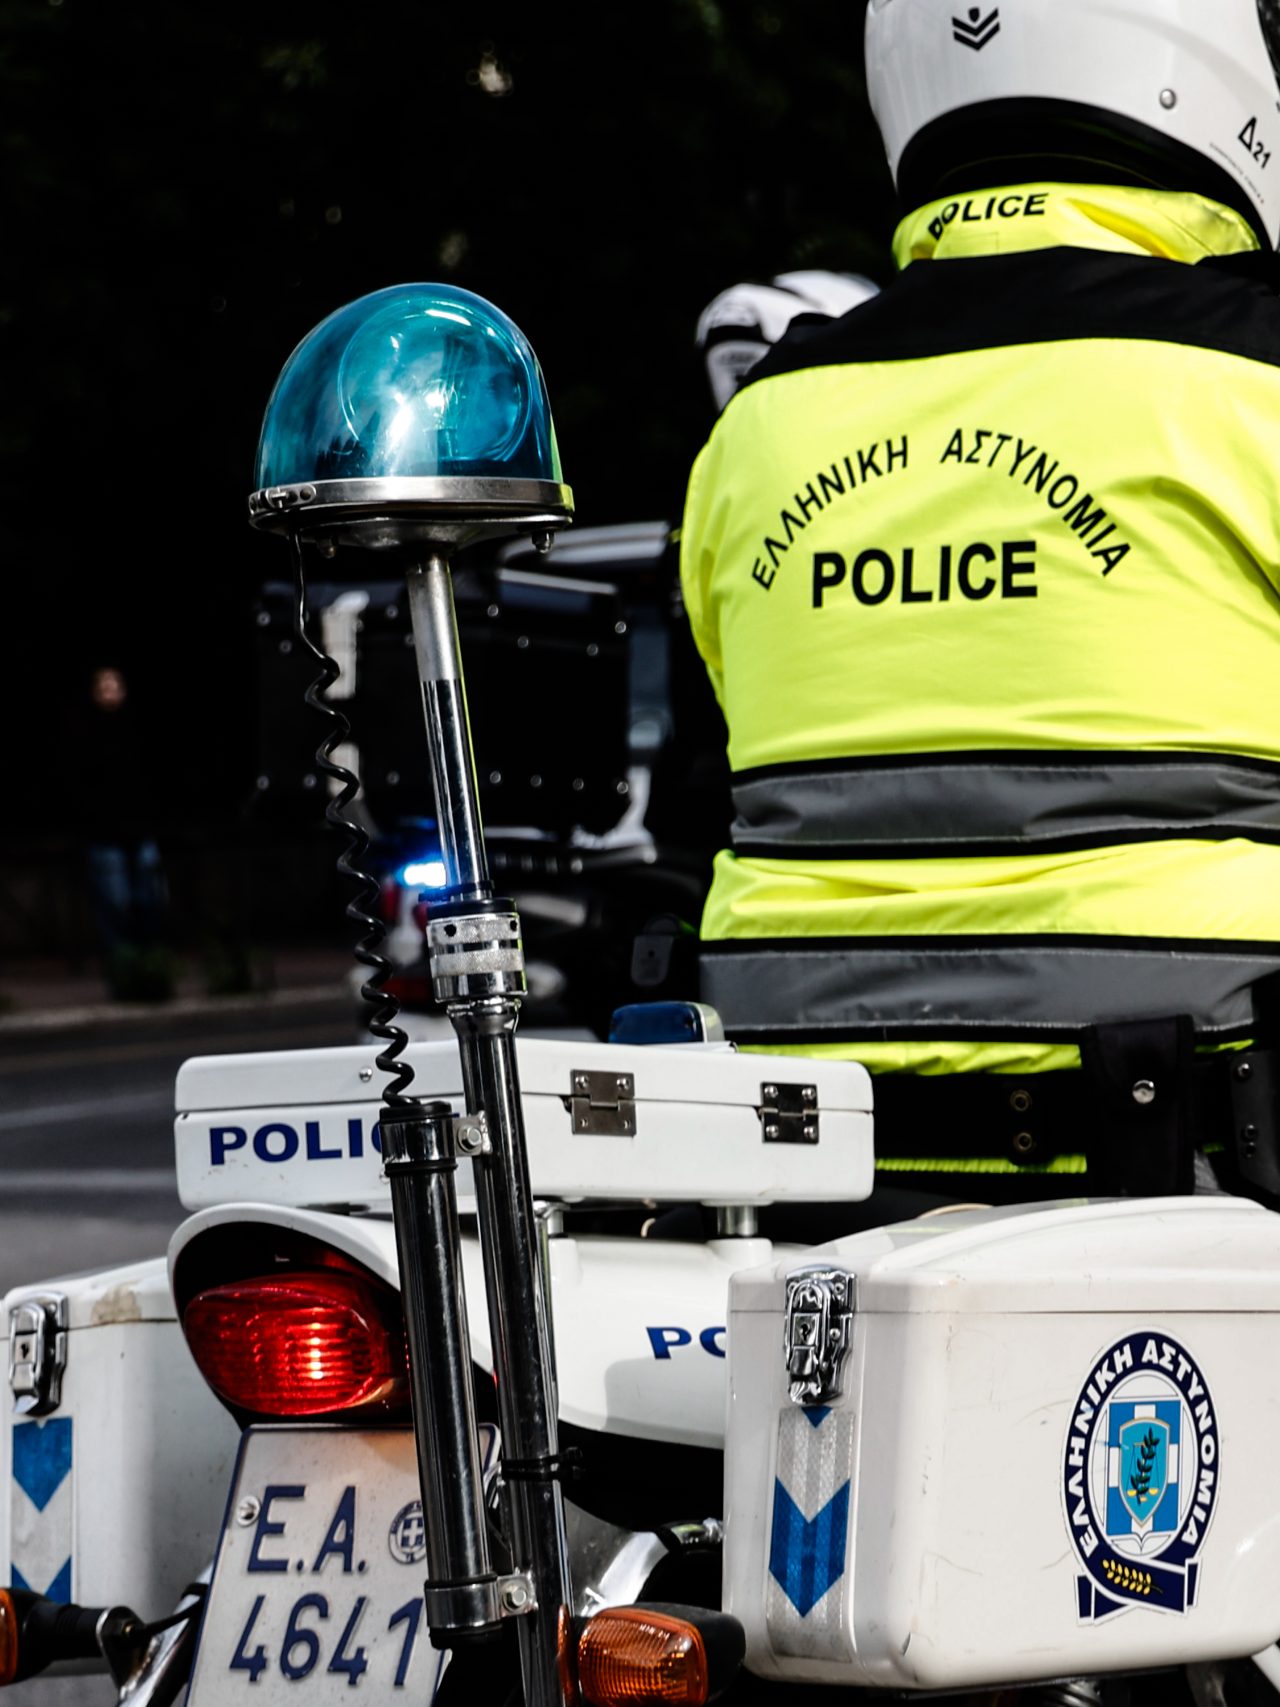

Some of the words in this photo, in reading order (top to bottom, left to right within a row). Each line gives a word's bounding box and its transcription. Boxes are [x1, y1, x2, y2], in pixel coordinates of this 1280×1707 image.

[752, 435, 908, 591] ΕΛΛΗΝΙΚΗ
[940, 428, 1132, 577] ΑΣΤΥΝΟΜΙΑ
[812, 540, 1037, 608] POLICE
[209, 1118, 382, 1166] POLI
[1068, 1343, 1134, 1558] ΕΛΛΗΝΙΚΗ
[1141, 1339, 1216, 1546] ΑΣΤΥΝΟΜΙΑ
[229, 1593, 424, 1686] 4641
